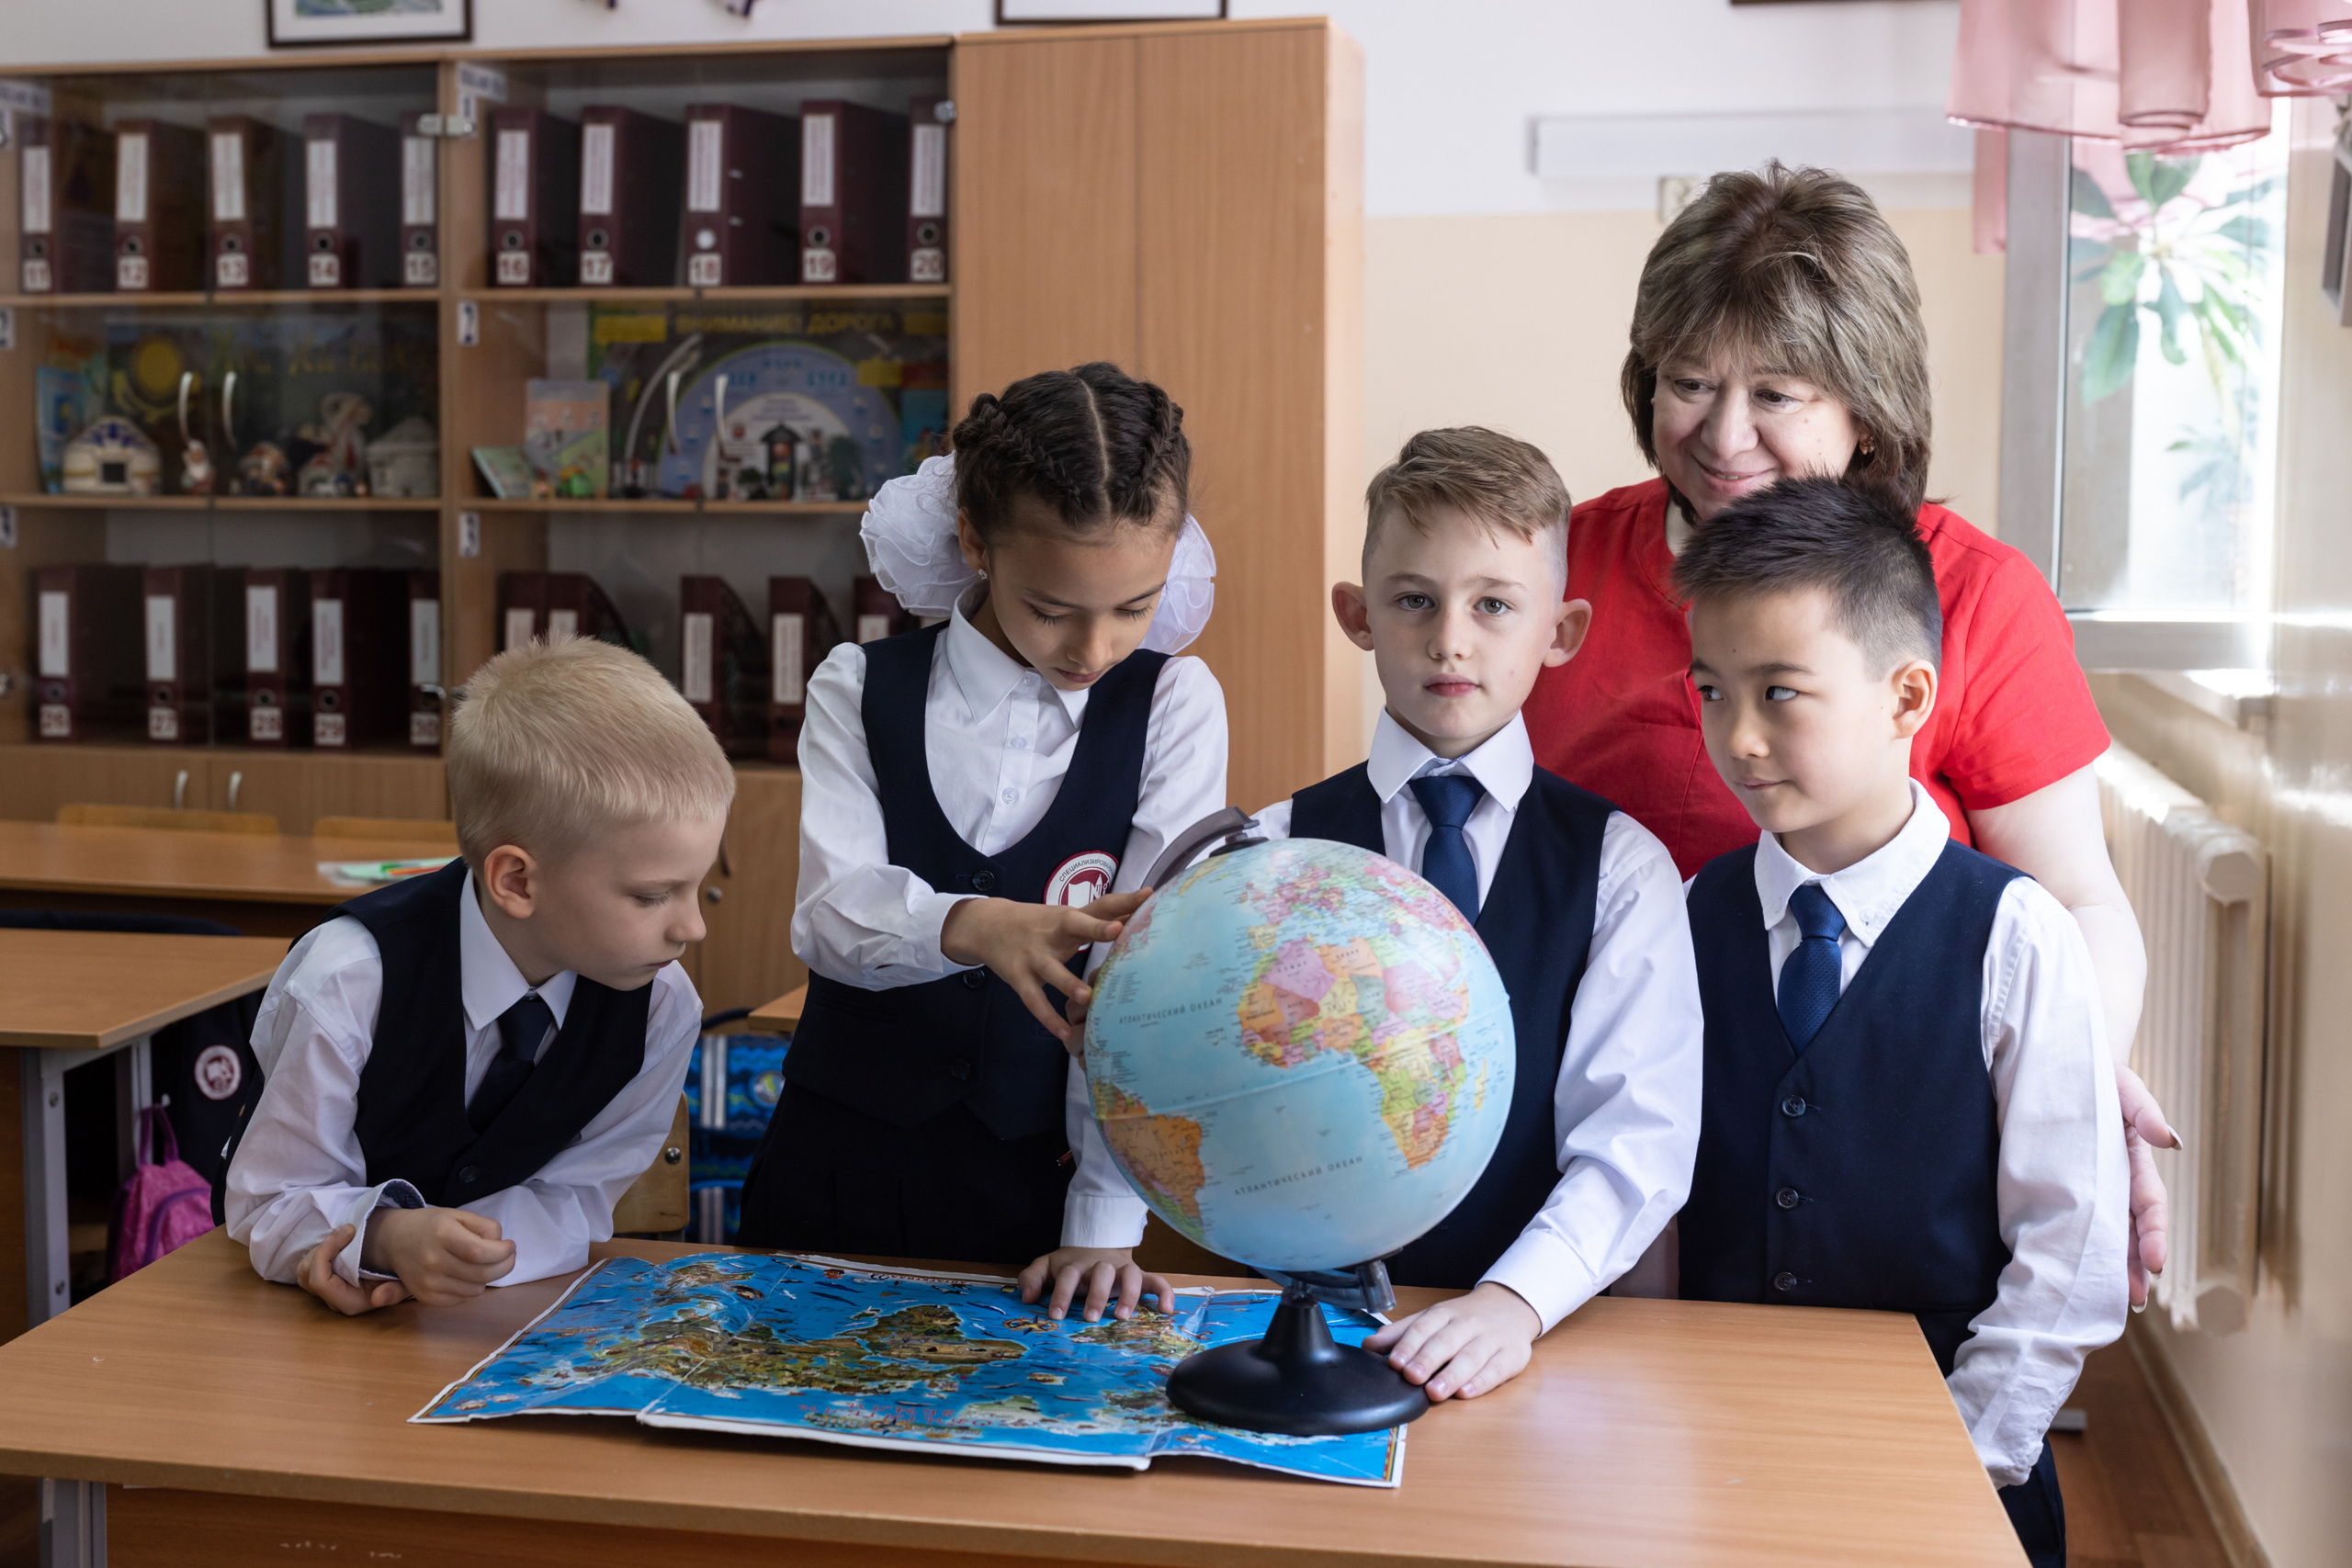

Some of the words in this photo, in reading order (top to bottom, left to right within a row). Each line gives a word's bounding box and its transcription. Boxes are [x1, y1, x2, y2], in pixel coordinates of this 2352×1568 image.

[1118, 1004, 1186, 1025] АТЛАНТИЧЕСКИЙ
[1190, 997, 1223, 1012] ОКЕАН
[1234, 1165, 1323, 1196] АТЛАНТИЧЕСКИЙ
[1328, 1155, 1363, 1172] ОКЕАН
